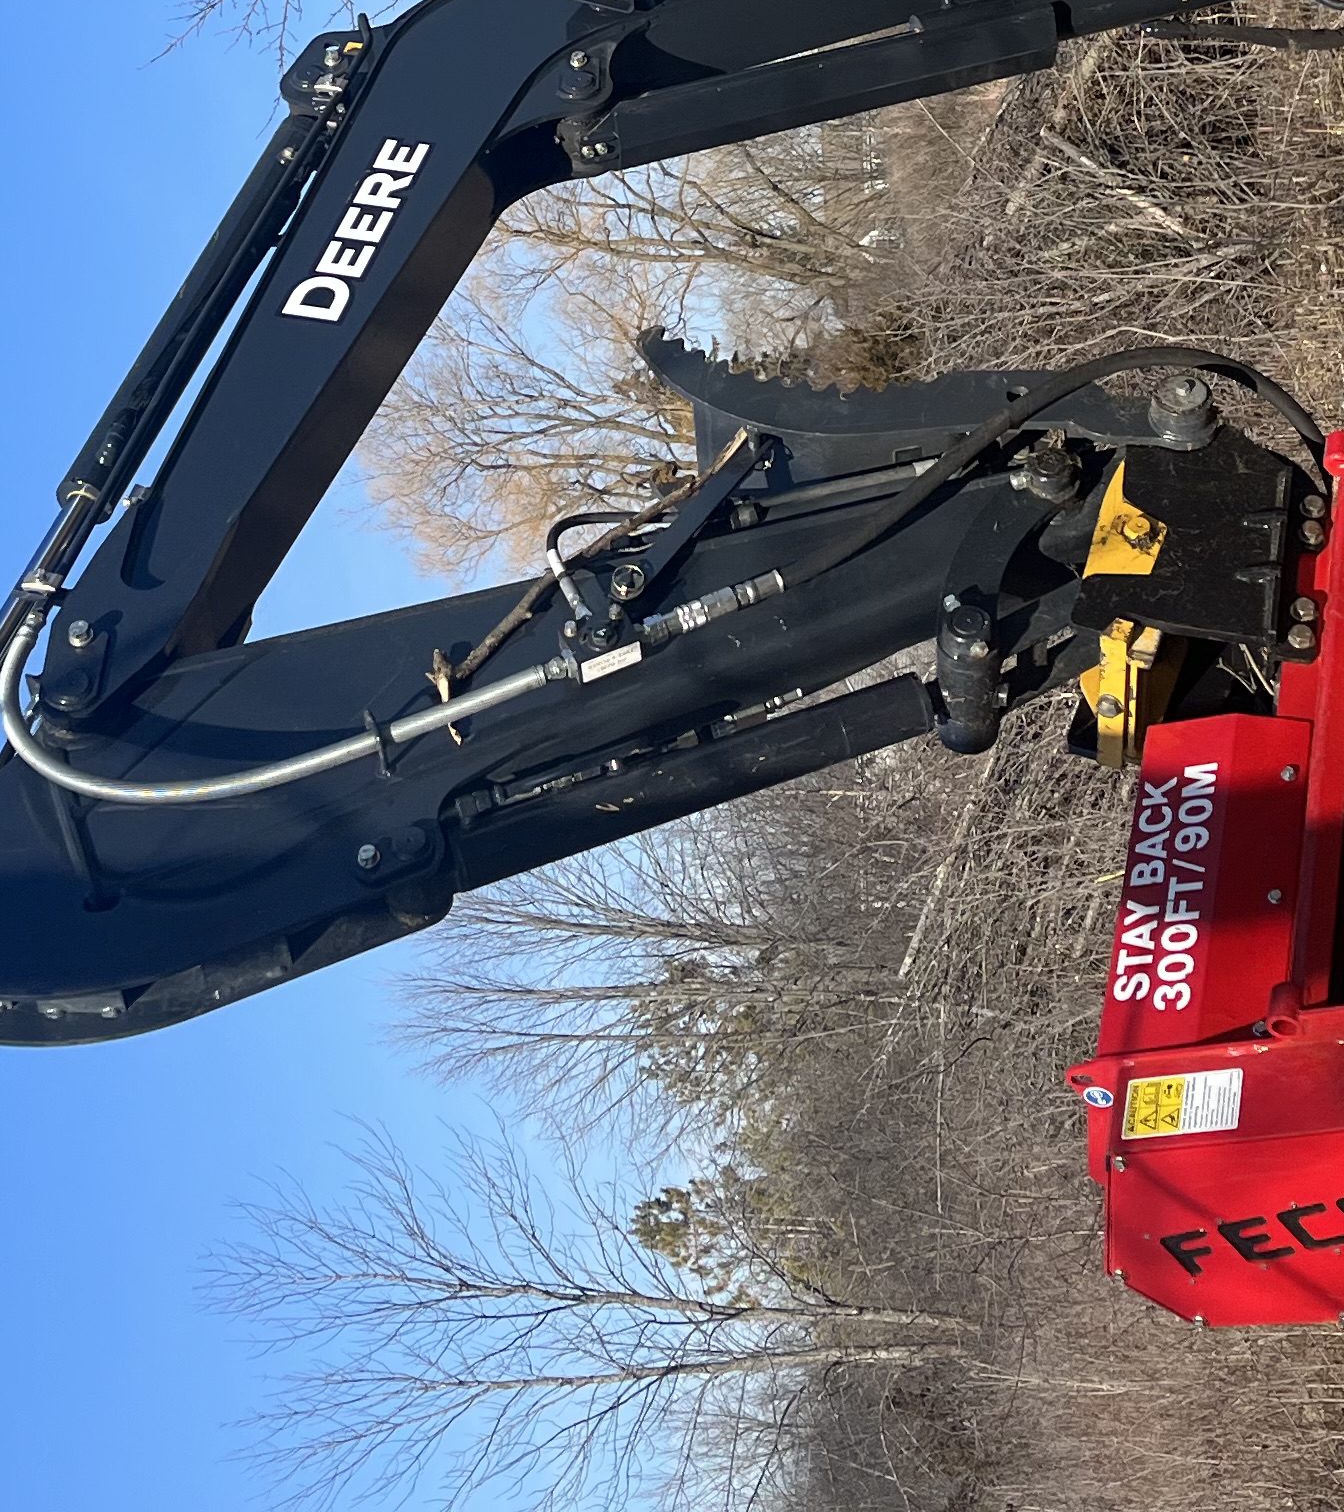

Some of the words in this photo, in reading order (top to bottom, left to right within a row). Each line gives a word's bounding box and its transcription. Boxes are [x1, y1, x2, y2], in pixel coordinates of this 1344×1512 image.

[281, 138, 430, 322] DEERE
[1129, 776, 1178, 887] BACK
[1113, 899, 1160, 1002] STAY
